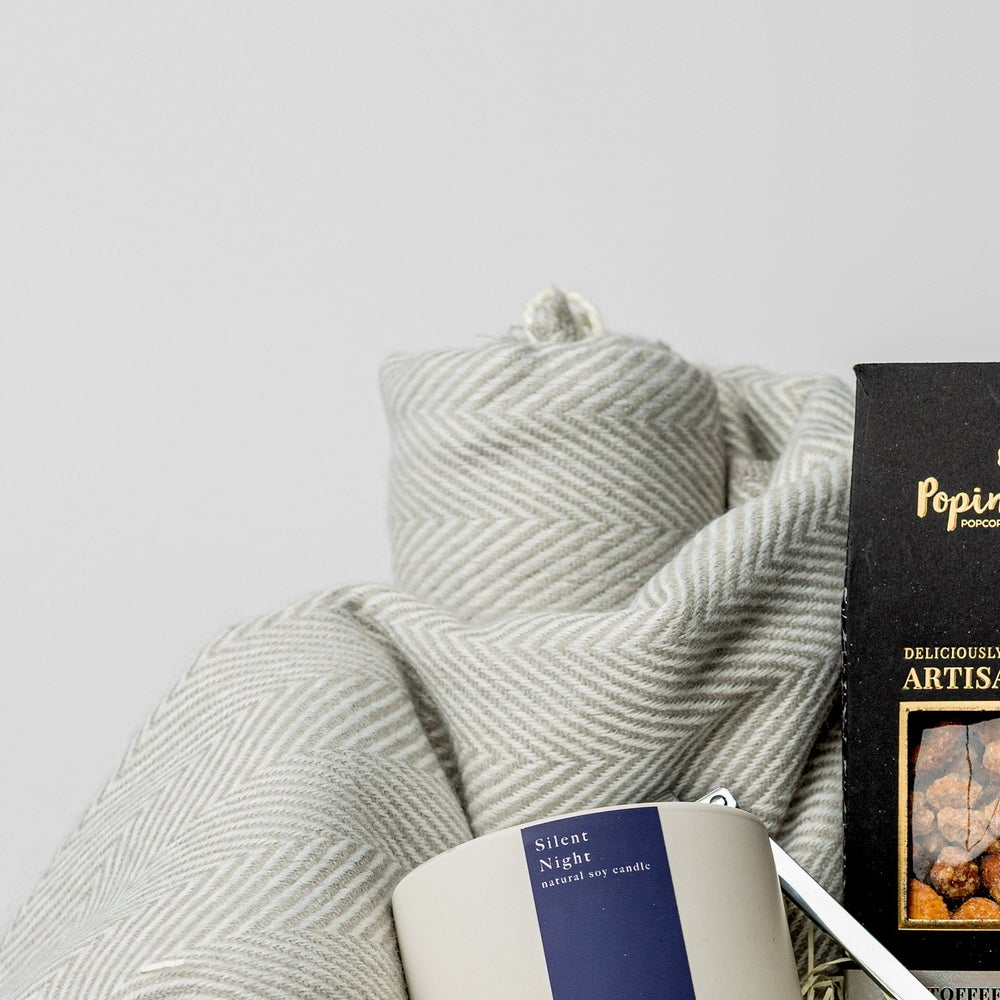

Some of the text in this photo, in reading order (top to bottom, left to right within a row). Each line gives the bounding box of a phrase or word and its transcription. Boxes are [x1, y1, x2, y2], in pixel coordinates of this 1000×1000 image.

[534, 831, 589, 852] Silent
[539, 852, 592, 872] Night
[541, 861, 651, 888] natural soy candle
